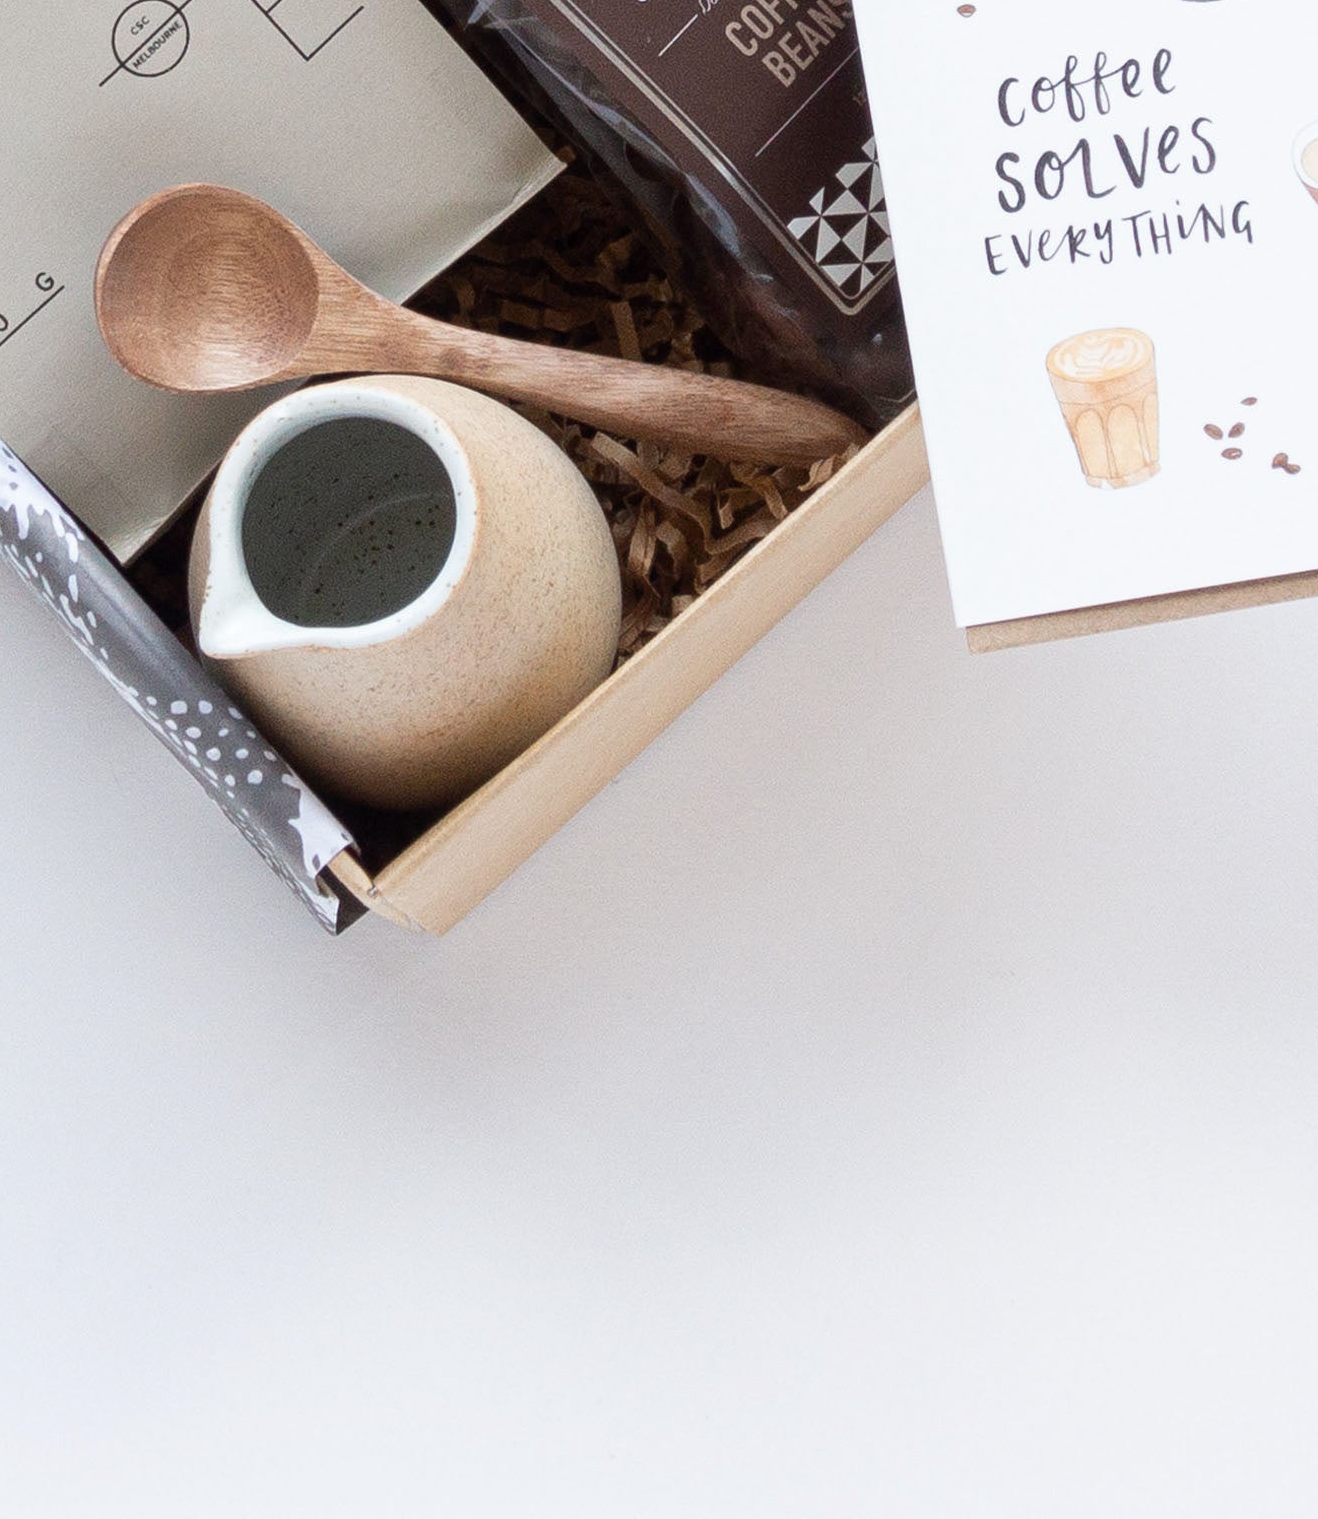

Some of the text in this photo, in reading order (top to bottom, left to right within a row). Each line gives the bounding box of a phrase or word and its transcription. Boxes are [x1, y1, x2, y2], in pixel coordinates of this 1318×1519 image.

[130, 15, 150, 36] CSC
[133, 20, 182, 69] MELBOURNE
[34, 270, 56, 295] G
